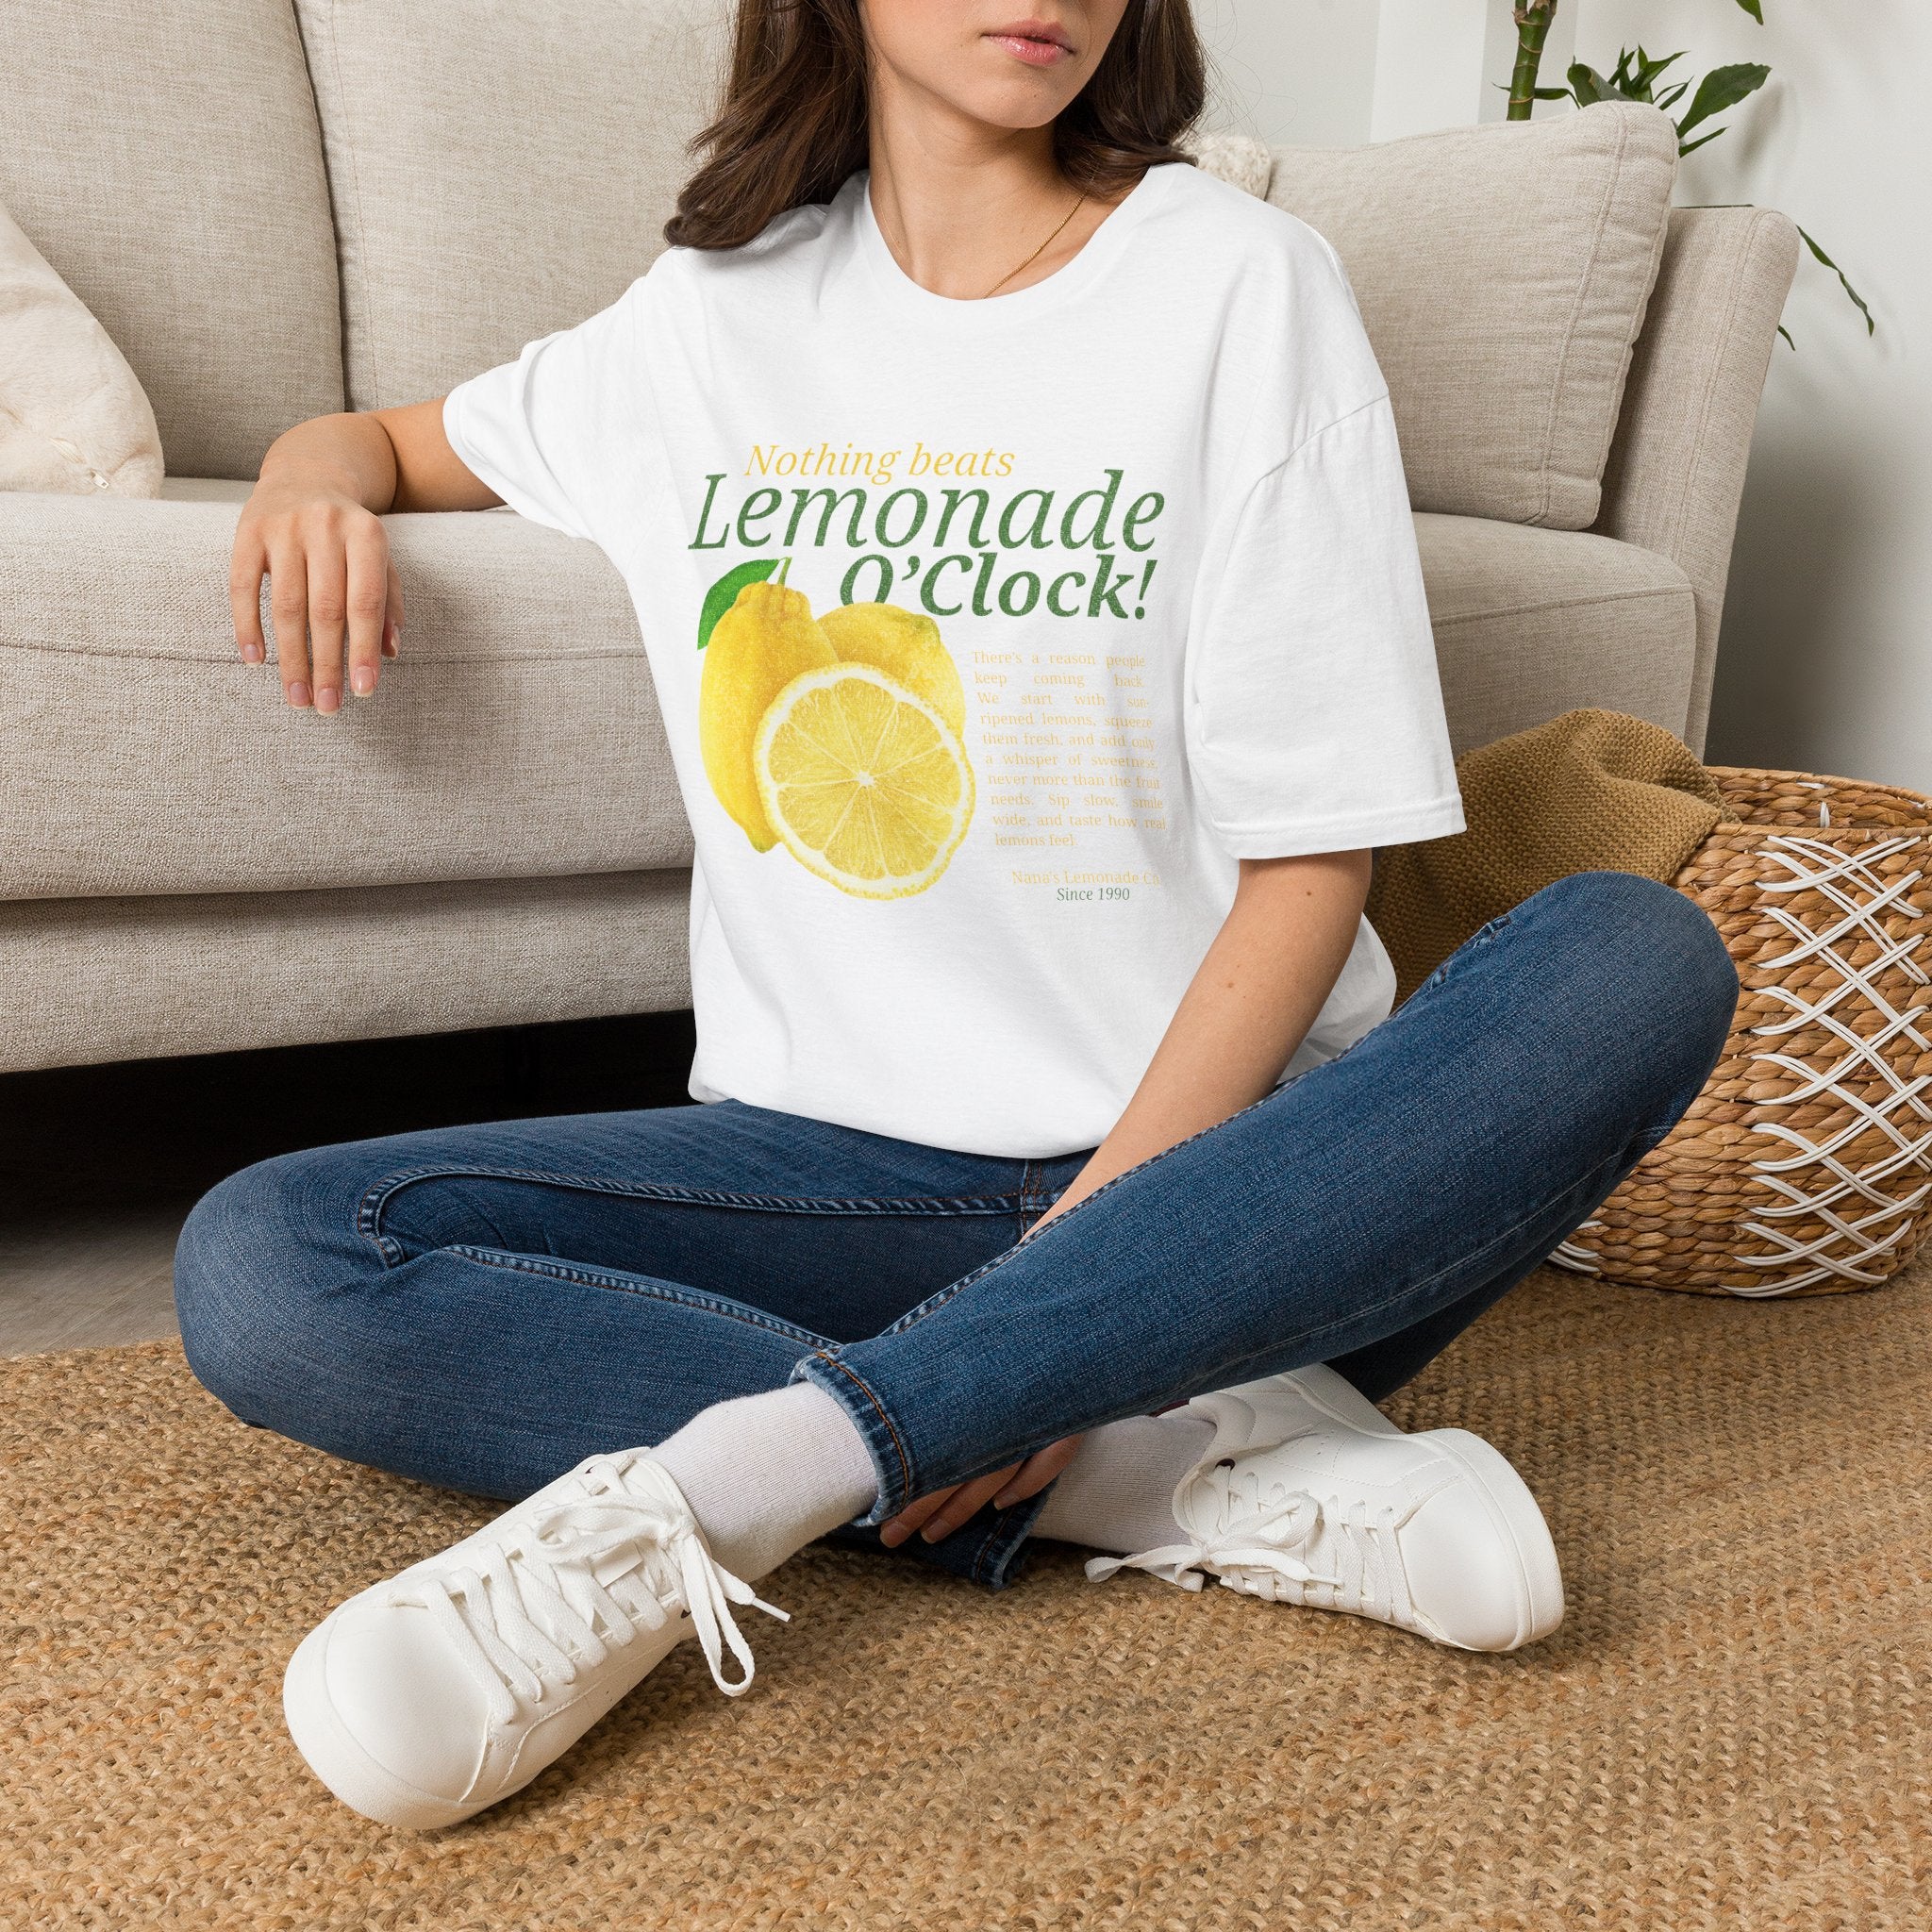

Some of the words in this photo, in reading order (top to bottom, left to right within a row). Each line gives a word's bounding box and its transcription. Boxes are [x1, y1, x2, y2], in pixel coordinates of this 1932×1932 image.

[744, 444, 902, 485] Nothing
[909, 443, 1015, 477] beats
[688, 469, 1165, 553] Lemonade
[1032, 655, 1040, 664] a
[1049, 654, 1096, 664] reason
[1106, 655, 1146, 671] people
[974, 672, 1007, 687] keep
[1034, 673, 1085, 688] coming
[977, 692, 1000, 704] We
[1022, 694, 1053, 705] start
[1074, 693, 1106, 706] with
[980, 712, 1034, 727] ripened
[1042, 713, 1096, 726] lemons,
[1105, 717, 1152, 730] squeeze
[983, 733, 1018, 745] them
[1069, 734, 1094, 746] and
[1101, 735, 1125, 747] add
[1131, 736, 1156, 751] only
[986, 756, 993, 765] a
[1003, 753, 1058, 768] whisper
[1068, 754, 1082, 765] of
[989, 774, 1027, 785] never
[1033, 776, 1068, 786] more
[1073, 774, 1105, 786] than
[1109, 774, 1131, 787] the
[1136, 776, 1161, 790] fruit
[1048, 793, 1070, 808] Sip
[1132, 796, 1163, 808] smile
[1038, 814, 1062, 825] and
[1070, 815, 1102, 826] taste
[1108, 814, 1139, 827] how
[995, 833, 1046, 846] lemons
[1064, 870, 1140, 885] Lemonade
[1057, 888, 1093, 901] Since
[1098, 888, 1130, 901] 1990
